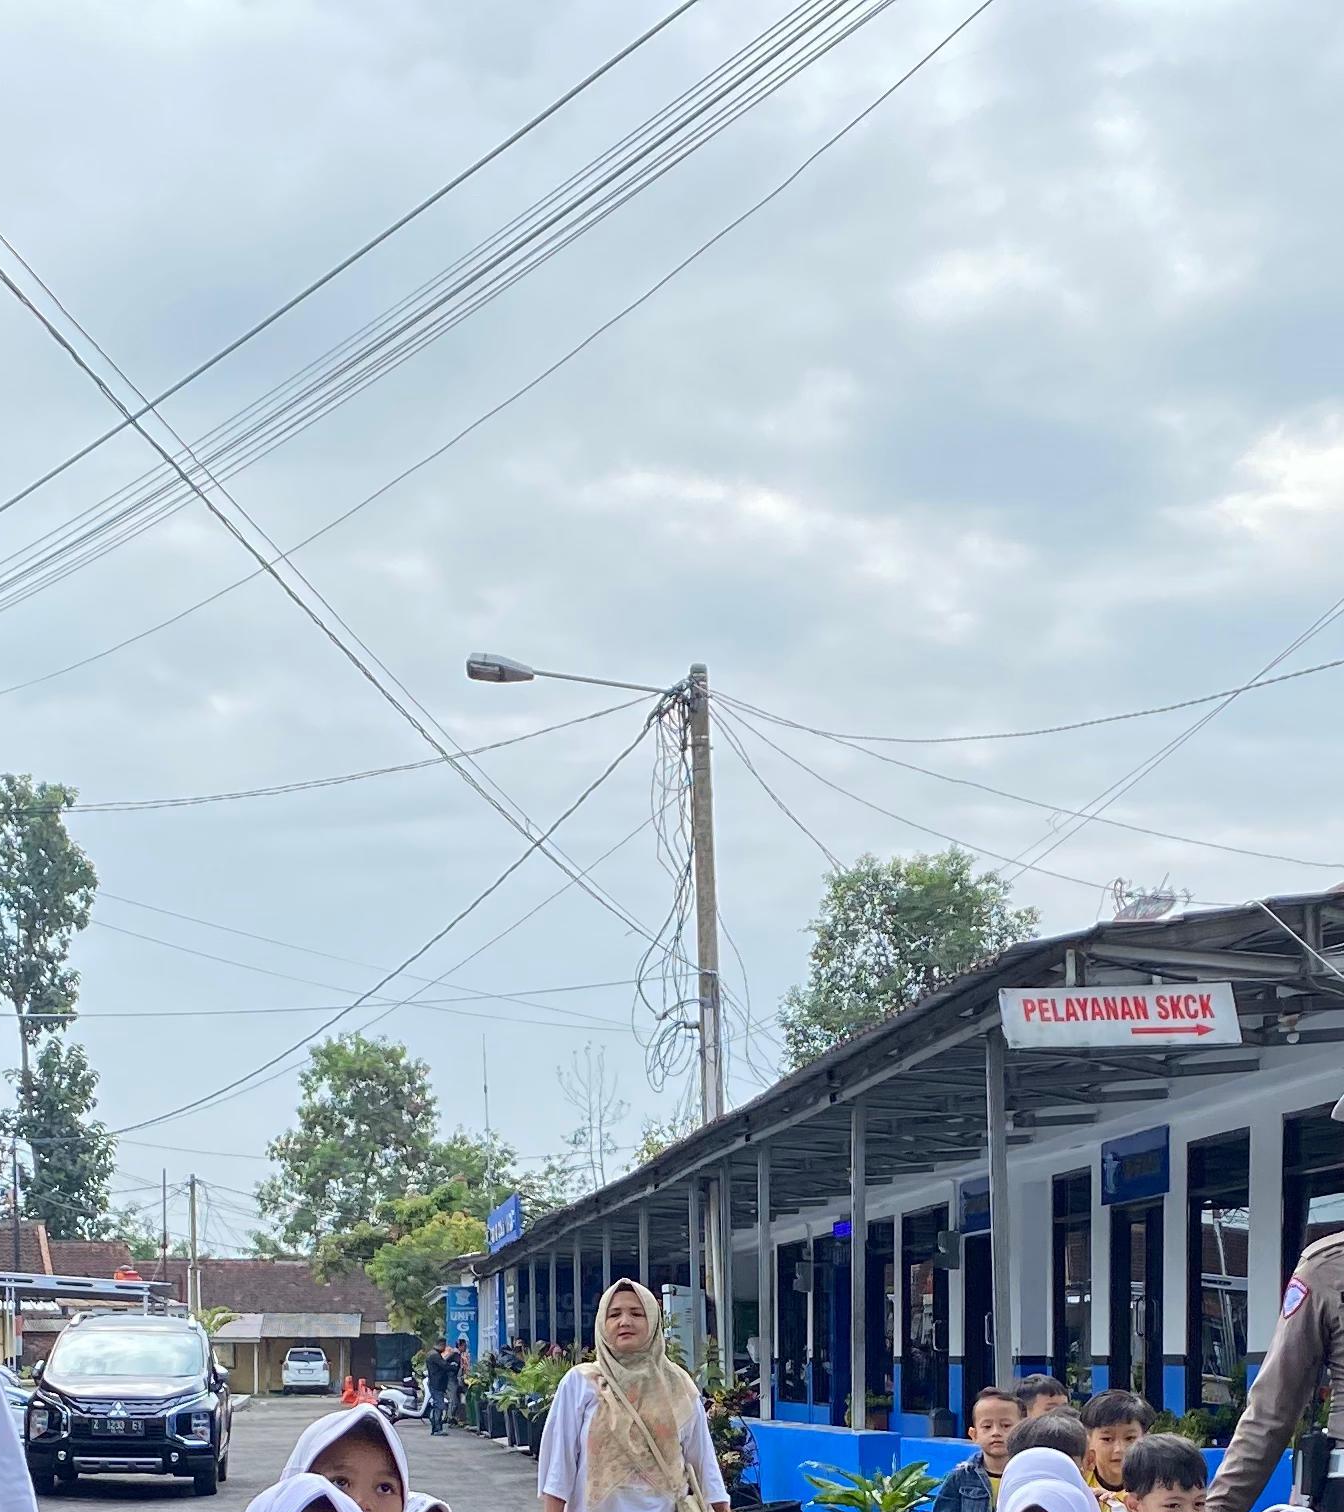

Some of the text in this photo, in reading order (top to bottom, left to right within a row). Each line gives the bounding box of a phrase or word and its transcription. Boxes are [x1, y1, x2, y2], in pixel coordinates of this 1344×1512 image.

[1022, 993, 1216, 1022] PELAYANAN SKCK
[450, 1311, 476, 1320] UNIT
